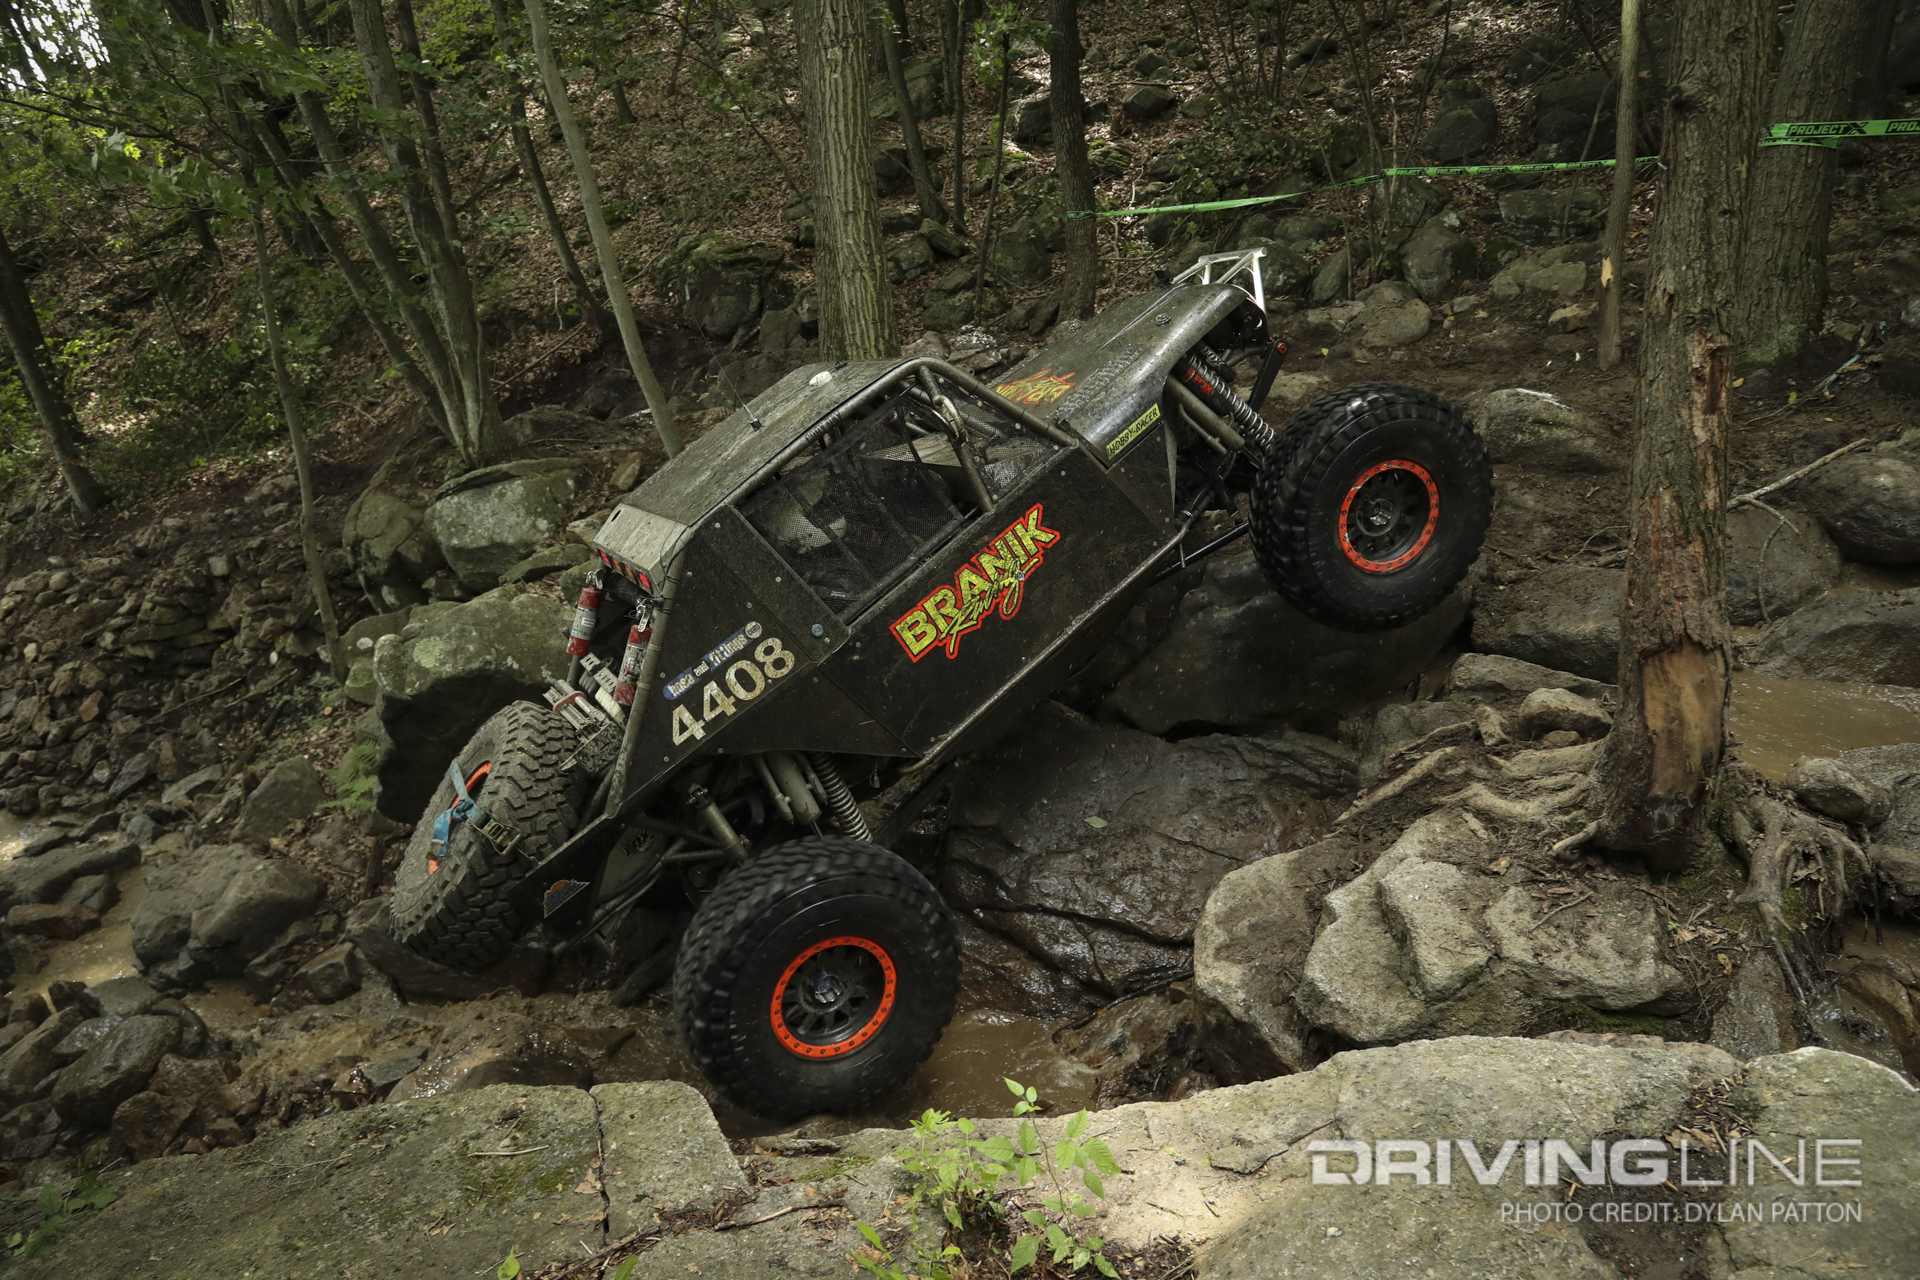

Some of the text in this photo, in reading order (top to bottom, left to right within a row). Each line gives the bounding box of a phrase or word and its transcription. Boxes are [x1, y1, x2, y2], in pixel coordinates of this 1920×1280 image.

[1787, 123, 1848, 136] PROJECT
[1200, 345, 1225, 367] FOX
[1191, 373, 1214, 396] FOX
[892, 506, 1058, 658] BRANIK
[672, 637, 796, 746] 4408
